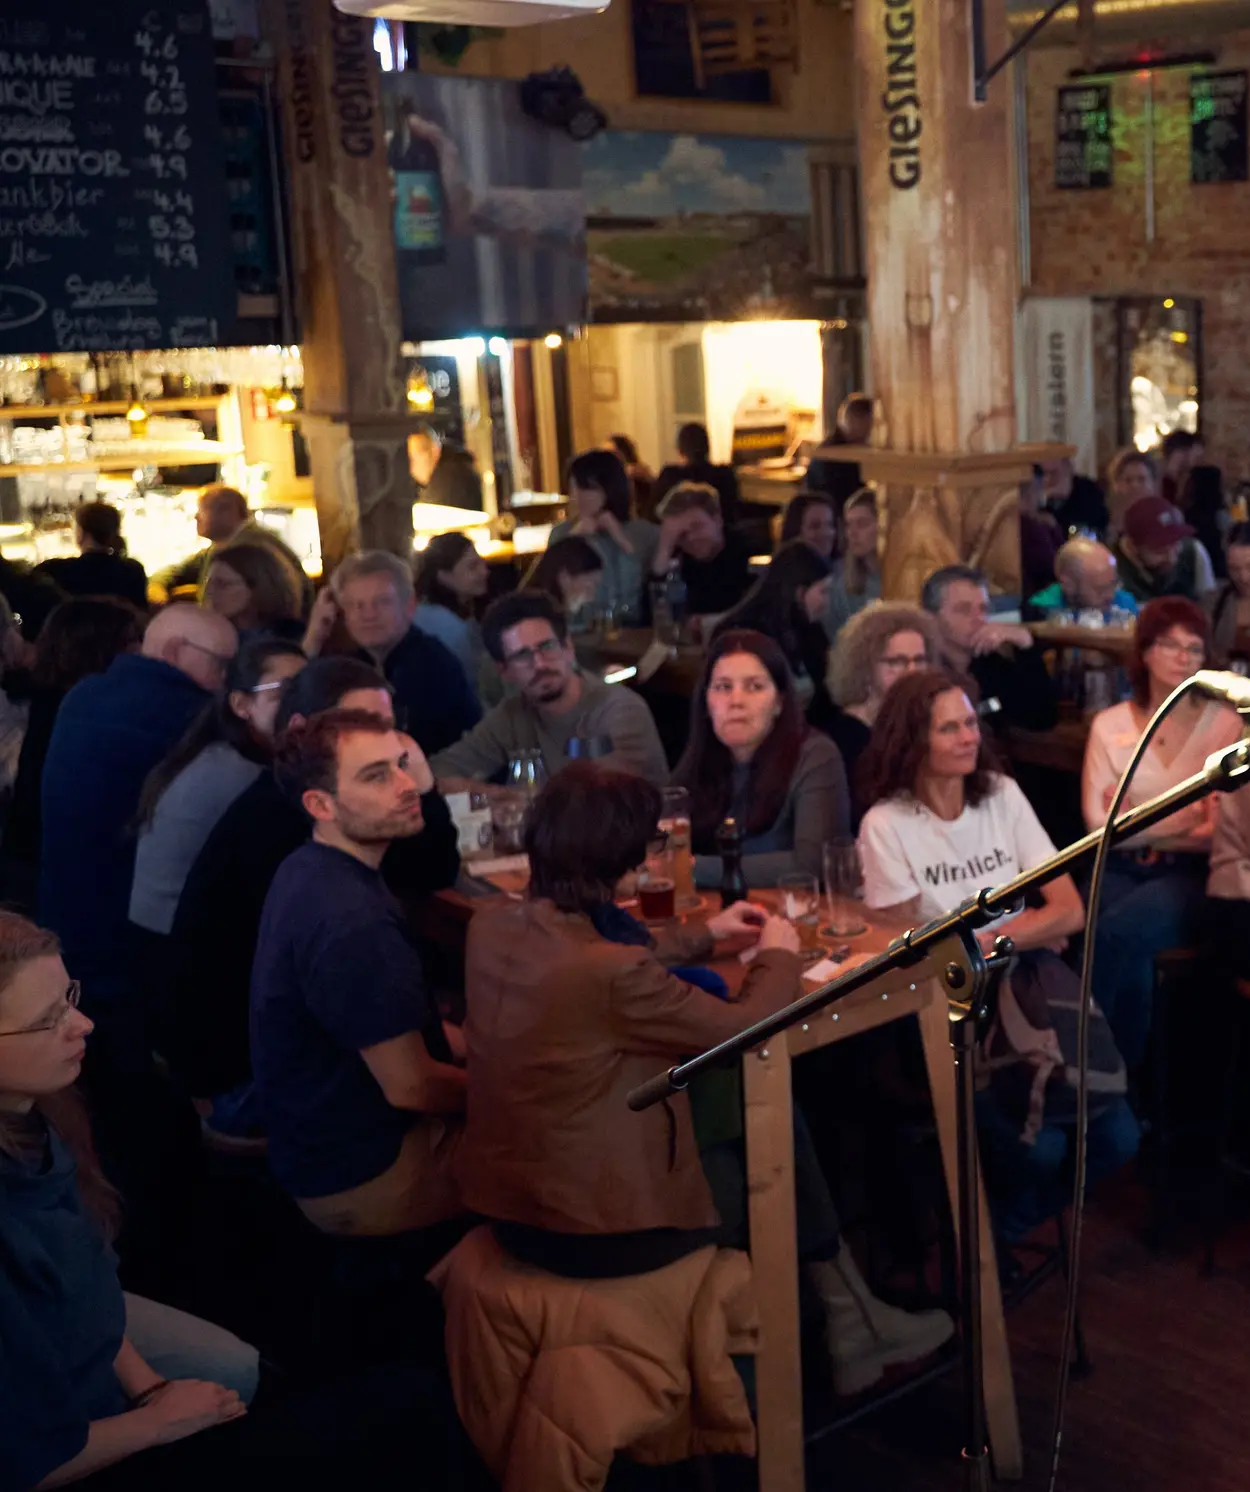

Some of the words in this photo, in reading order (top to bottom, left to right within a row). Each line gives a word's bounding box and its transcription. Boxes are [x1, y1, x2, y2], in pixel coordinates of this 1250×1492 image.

[135, 32, 179, 60] 4.6
[145, 89, 189, 115] 6.5
[144, 123, 192, 151] 4.6
[149, 153, 188, 180] 4.9
[154, 189, 194, 216] 4.4
[154, 242, 199, 269] 4.9
